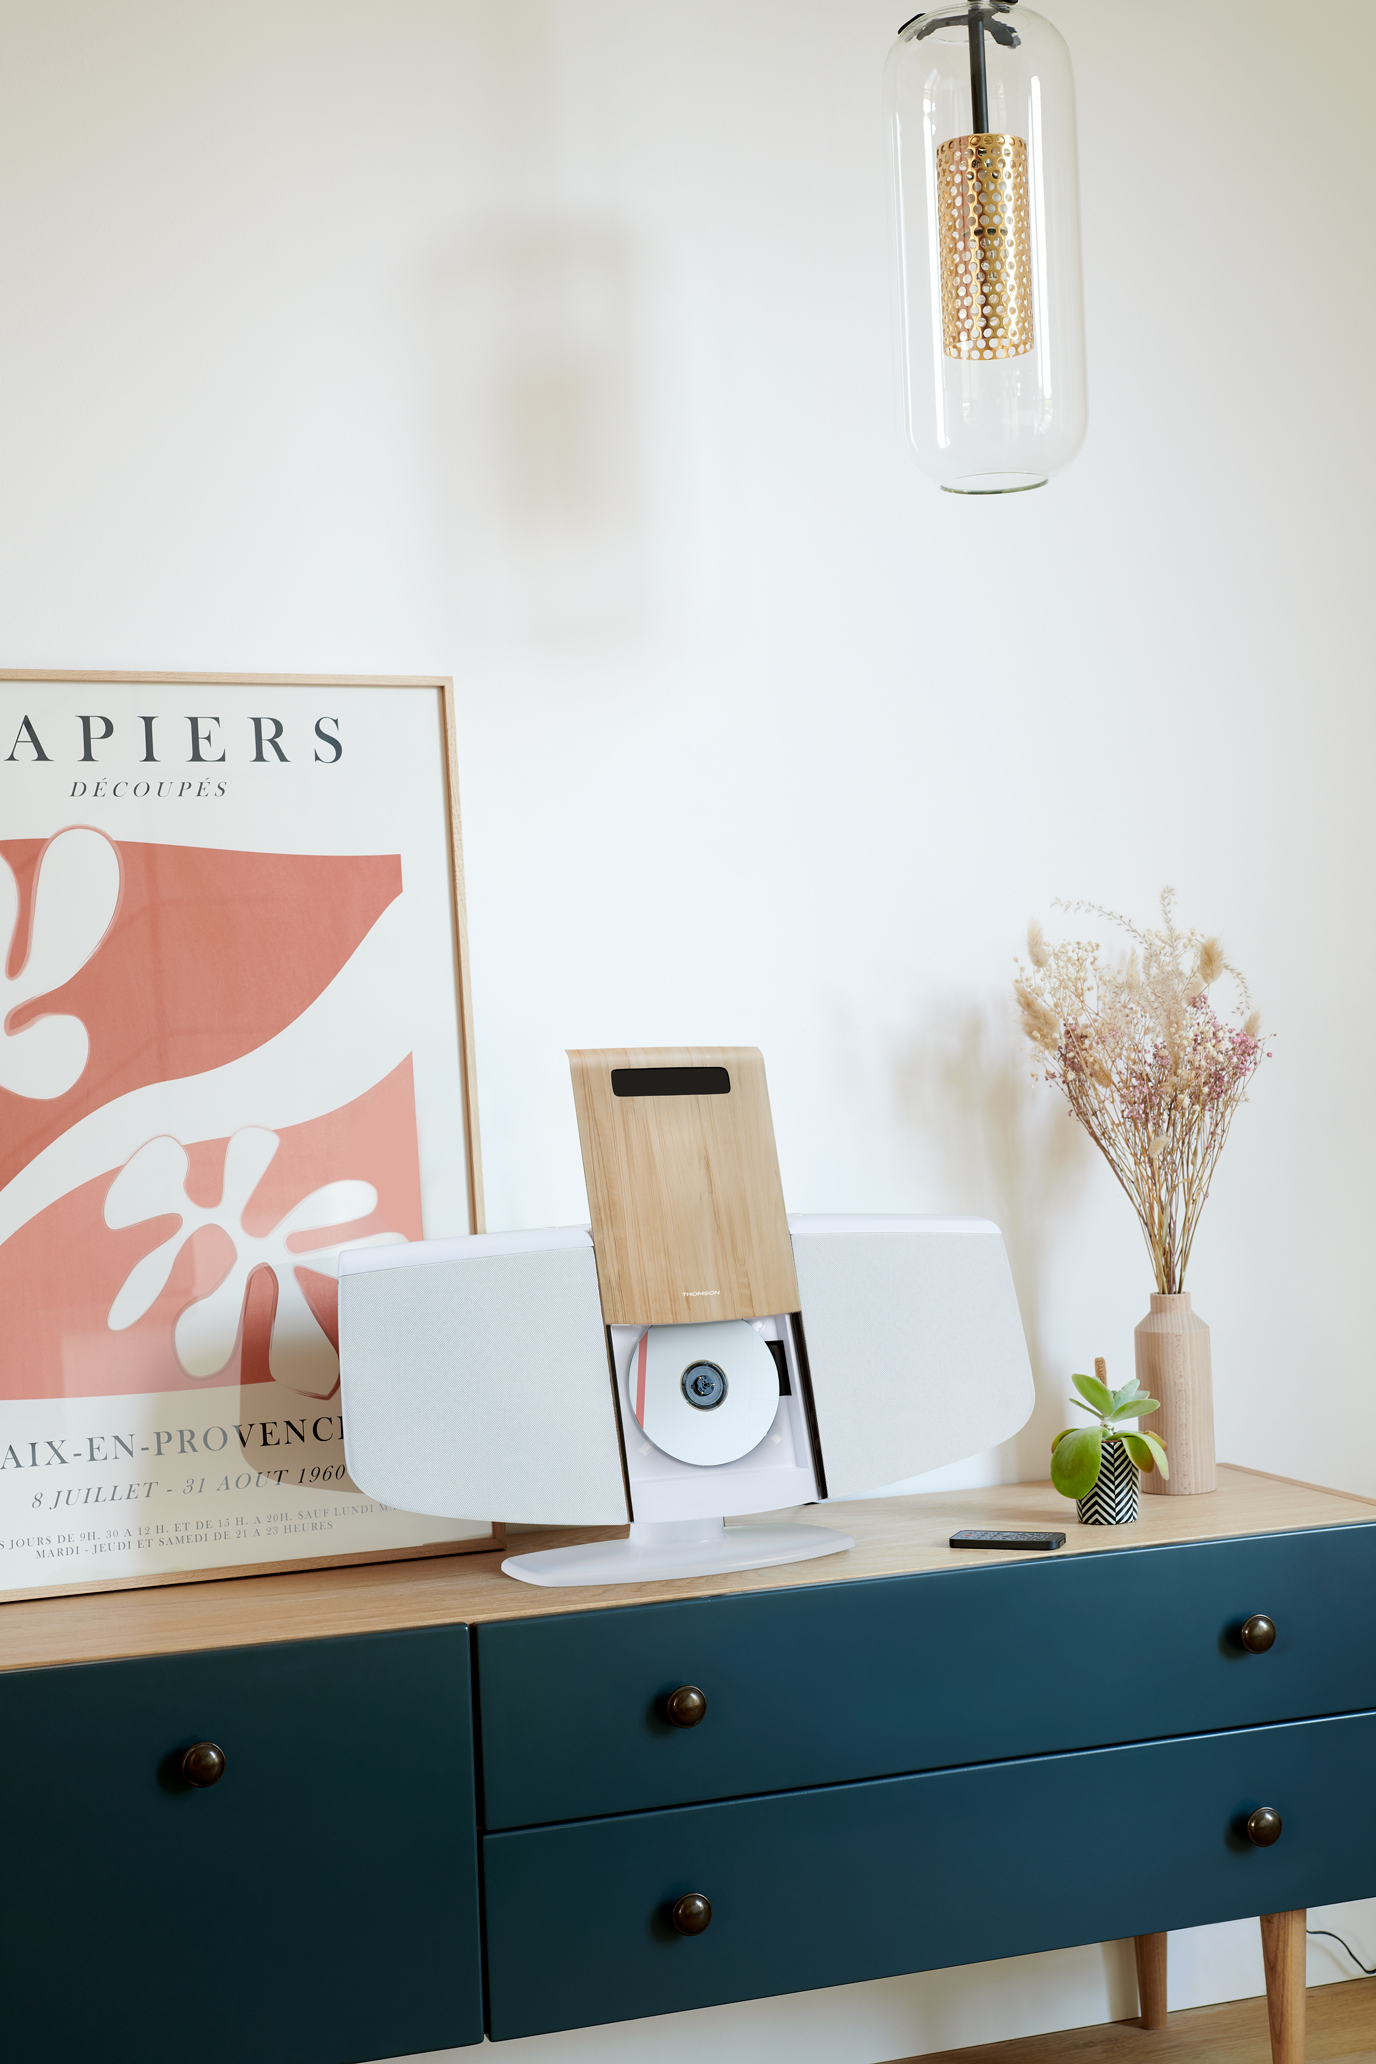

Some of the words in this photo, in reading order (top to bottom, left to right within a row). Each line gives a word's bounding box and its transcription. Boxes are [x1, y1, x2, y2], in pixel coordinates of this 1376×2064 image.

[4, 714, 344, 764] APIERS
[70, 777, 228, 798] DÉCOUPÉS
[31, 1492, 43, 1509] 8
[49, 1481, 159, 1510] JUILLET
[182, 1477, 206, 1495] 31
[216, 1469, 289, 1492] AOUT
[298, 1464, 346, 1484] 1960
[9, 1535, 52, 1550] JOURS
[57, 1533, 75, 1544] DE
[80, 1531, 101, 1542] 9H.
[106, 1529, 119, 1539] 30
[124, 1528, 132, 1538] A
[138, 1526, 150, 1536] 12
[155, 1524, 169, 1535] H.
[174, 1522, 191, 1532] ET
[196, 1520, 213, 1530] DE
[218, 1518, 230, 1528] 15
[235, 1516, 249, 1526] H.
[254, 1515, 261, 1525] A
[266, 1512, 293, 1523] 20H.
[298, 1508, 330, 1520] SAUF
[334, 1504, 374, 1516] LUNDI
[36, 1545, 80, 1559] MARDI
[92, 1541, 131, 1555] JEUDI
[137, 1539, 154, 1549] ET
[158, 1533, 208, 1547] SAMEDI
[214, 1531, 231, 1541] DE
[235, 1529, 247, 1539] 21
[253, 1528, 261, 1537] A
[266, 1526, 279, 1536] 23
[283, 1521, 333, 1534] HEURES
